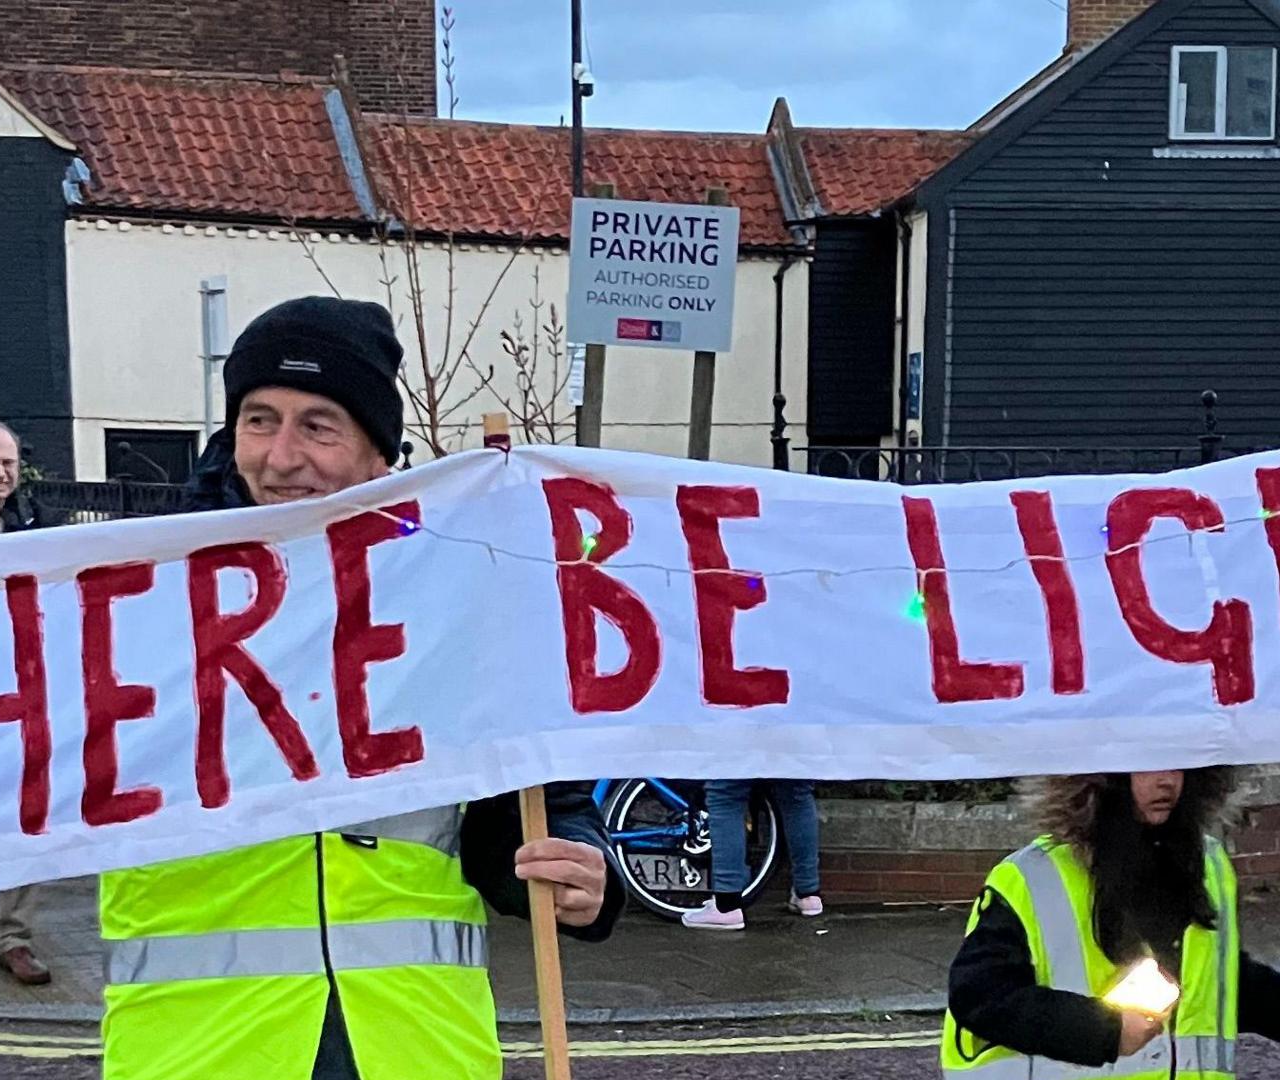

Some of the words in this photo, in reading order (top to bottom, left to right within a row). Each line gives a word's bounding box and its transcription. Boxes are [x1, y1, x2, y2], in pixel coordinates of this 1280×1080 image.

[591, 210, 720, 240] PRIVATE
[589, 237, 719, 267] PARKING
[593, 269, 710, 291] AUTHORISED
[586, 290, 664, 311] PARKING
[668, 296, 716, 312] ONLY
[543, 476, 790, 714] BE
